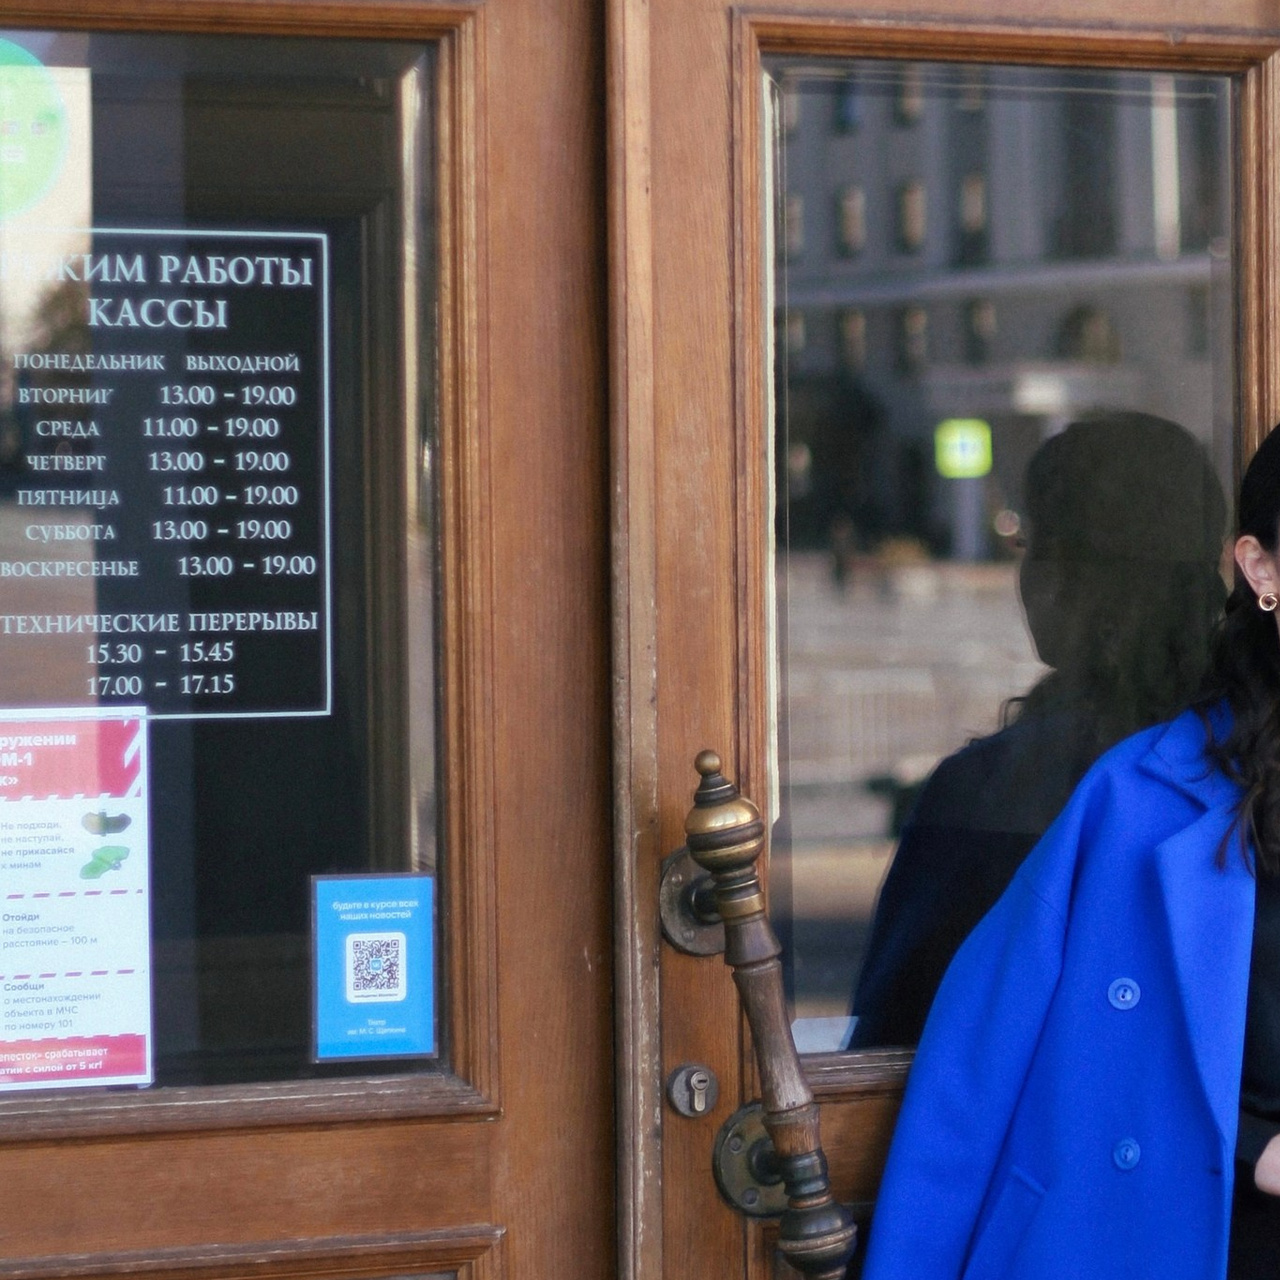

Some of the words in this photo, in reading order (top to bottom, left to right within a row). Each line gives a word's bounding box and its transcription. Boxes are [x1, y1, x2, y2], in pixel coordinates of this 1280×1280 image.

[160, 255, 313, 286] РАБОТЫ
[88, 298, 227, 328] КАССЫ
[14, 353, 165, 372] ПОНЕДЕЛЬНИК
[185, 353, 299, 373] ВЫХОДНОЙ
[159, 385, 215, 405] 13.00
[241, 385, 296, 405] 19.00
[36, 420, 100, 438] СРЕДА
[143, 418, 198, 437] 11.00
[224, 418, 279, 437] 19.00
[26, 455, 106, 472] ЧЕТВЕРГ
[149, 452, 204, 471] 13.00
[234, 452, 289, 471] 19.00
[17, 489, 120, 510] ПЯТНИЦА
[163, 486, 218, 505] 11.00
[244, 485, 298, 505] 19.00
[25, 524, 116, 543] СУББОТА
[152, 520, 207, 540] 13.00
[236, 520, 291, 539] 19.00
[0, 560, 139, 577] ВОСКРЕСЕНЬЕ
[178, 556, 233, 576] 13.00
[261, 555, 316, 575] 19.00
[0, 613, 180, 634] ТЕХНИЧЕСКИЕ
[188, 612, 318, 632] ПЕРЕРЫВЫ
[86, 643, 142, 663] 15.30
[180, 641, 234, 662] 15.45
[87, 676, 142, 696] 17.00
[180, 674, 235, 694] 17.15
[0, 752, 33, 766] М-1
